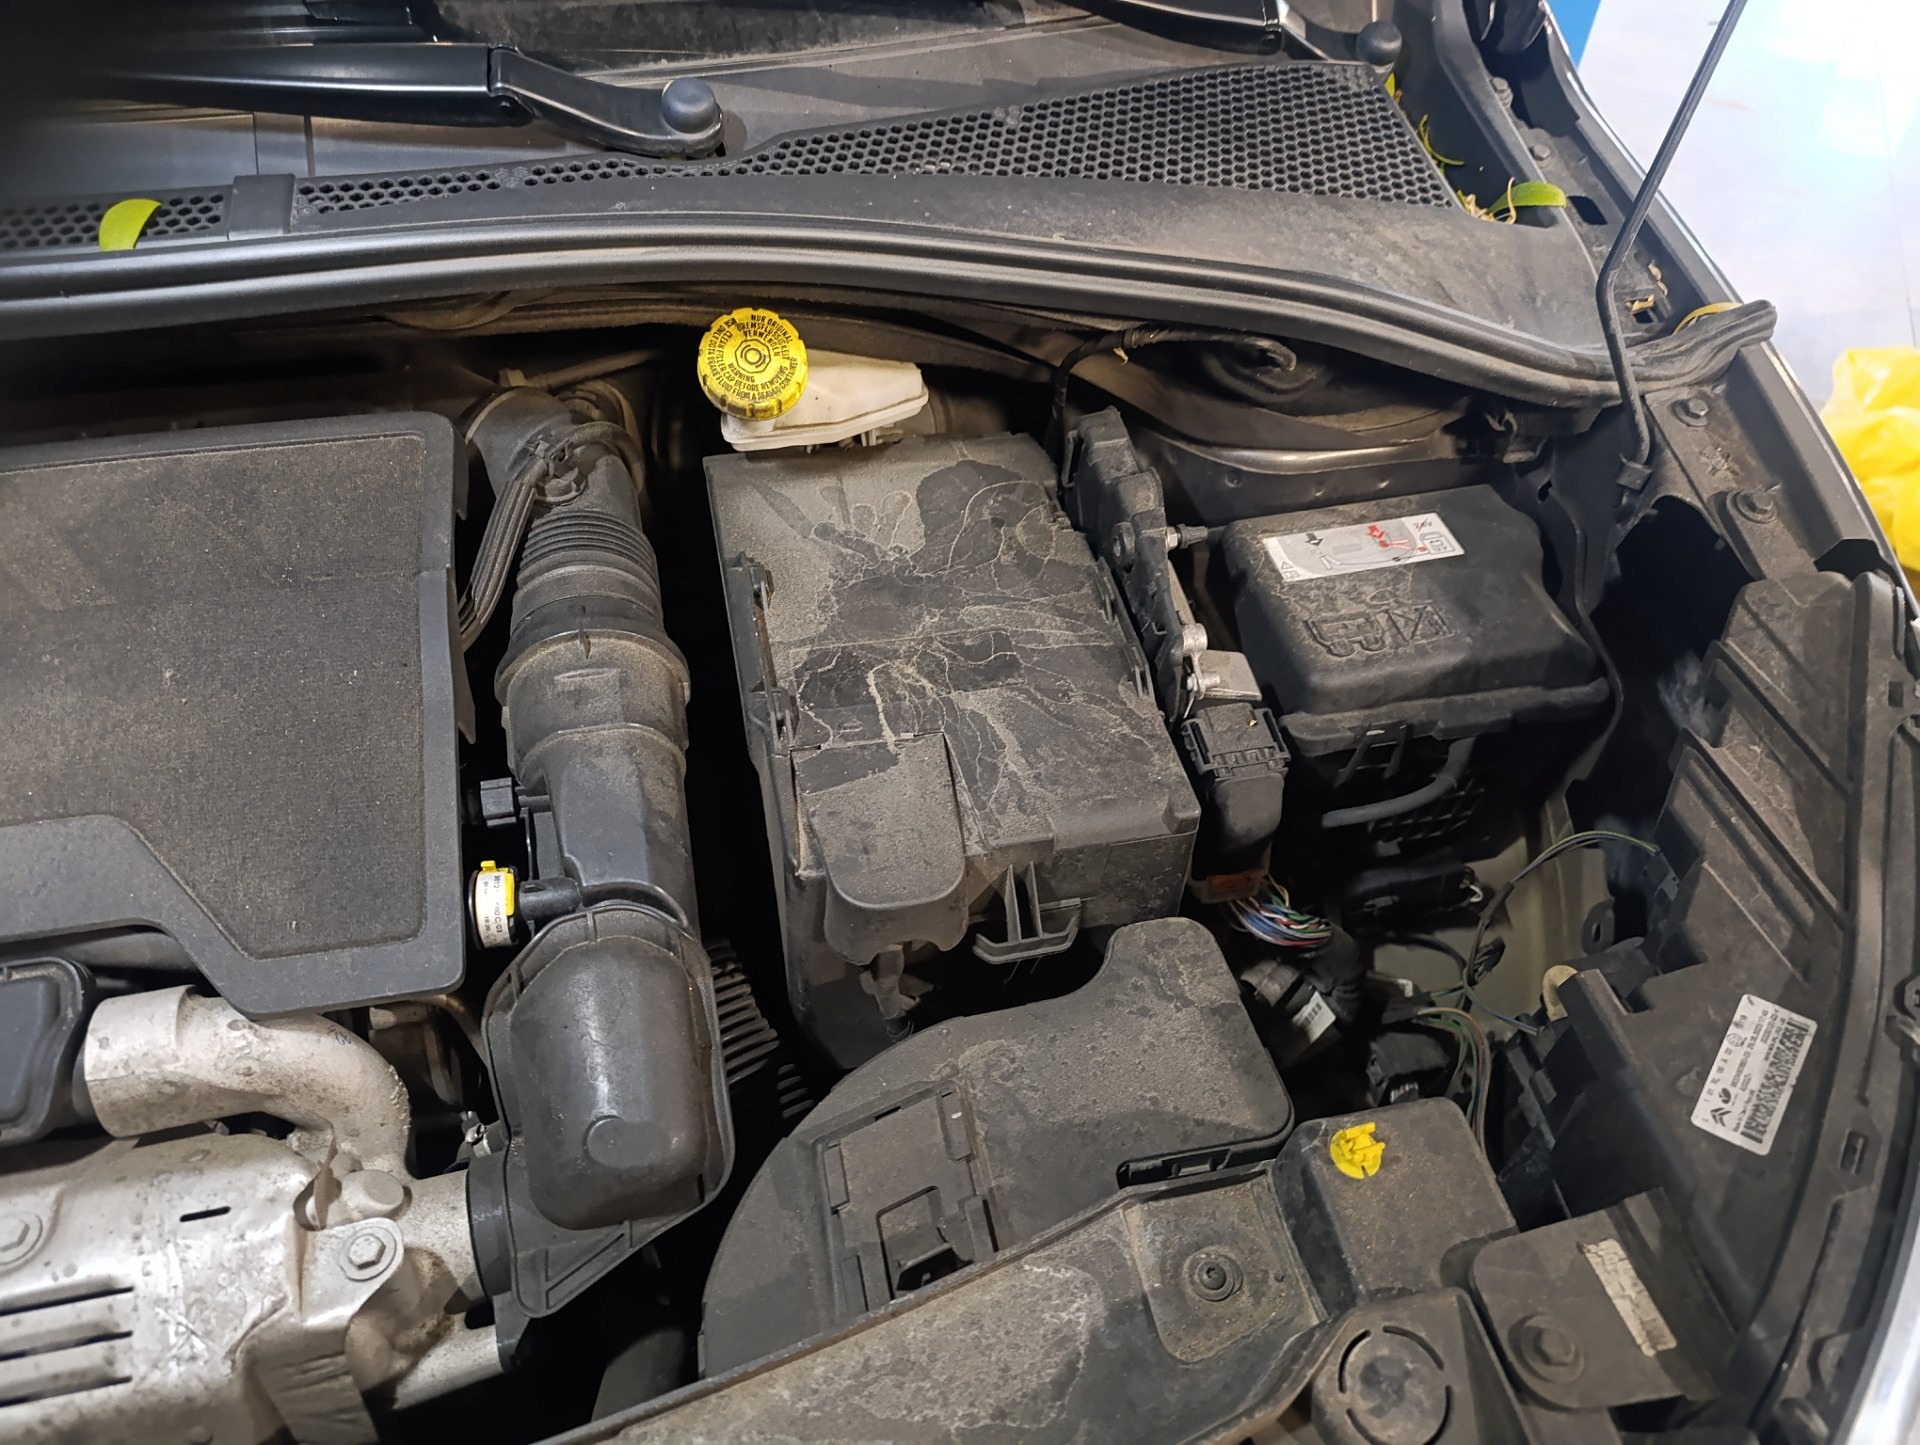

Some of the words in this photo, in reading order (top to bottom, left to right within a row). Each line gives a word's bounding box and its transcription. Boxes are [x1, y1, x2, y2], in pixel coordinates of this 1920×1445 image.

[712, 325, 726, 342] ONLY
[719, 330, 734, 348] CLEAN
[751, 314, 766, 323] NUR
[767, 318, 793, 344] ORIGINAL
[743, 330, 780, 357] VERWENDEN
[707, 356, 719, 377] BRAKE
[715, 350, 726, 372] FILLER
[723, 370, 735, 382] CAP
[727, 362, 756, 383] WARNING
[761, 365, 788, 391] REMOVING
[780, 356, 798, 390] CONTAINER
[715, 375, 733, 392] FLUID
[731, 388, 751, 400] FROM
[734, 379, 760, 391] BEFORE
